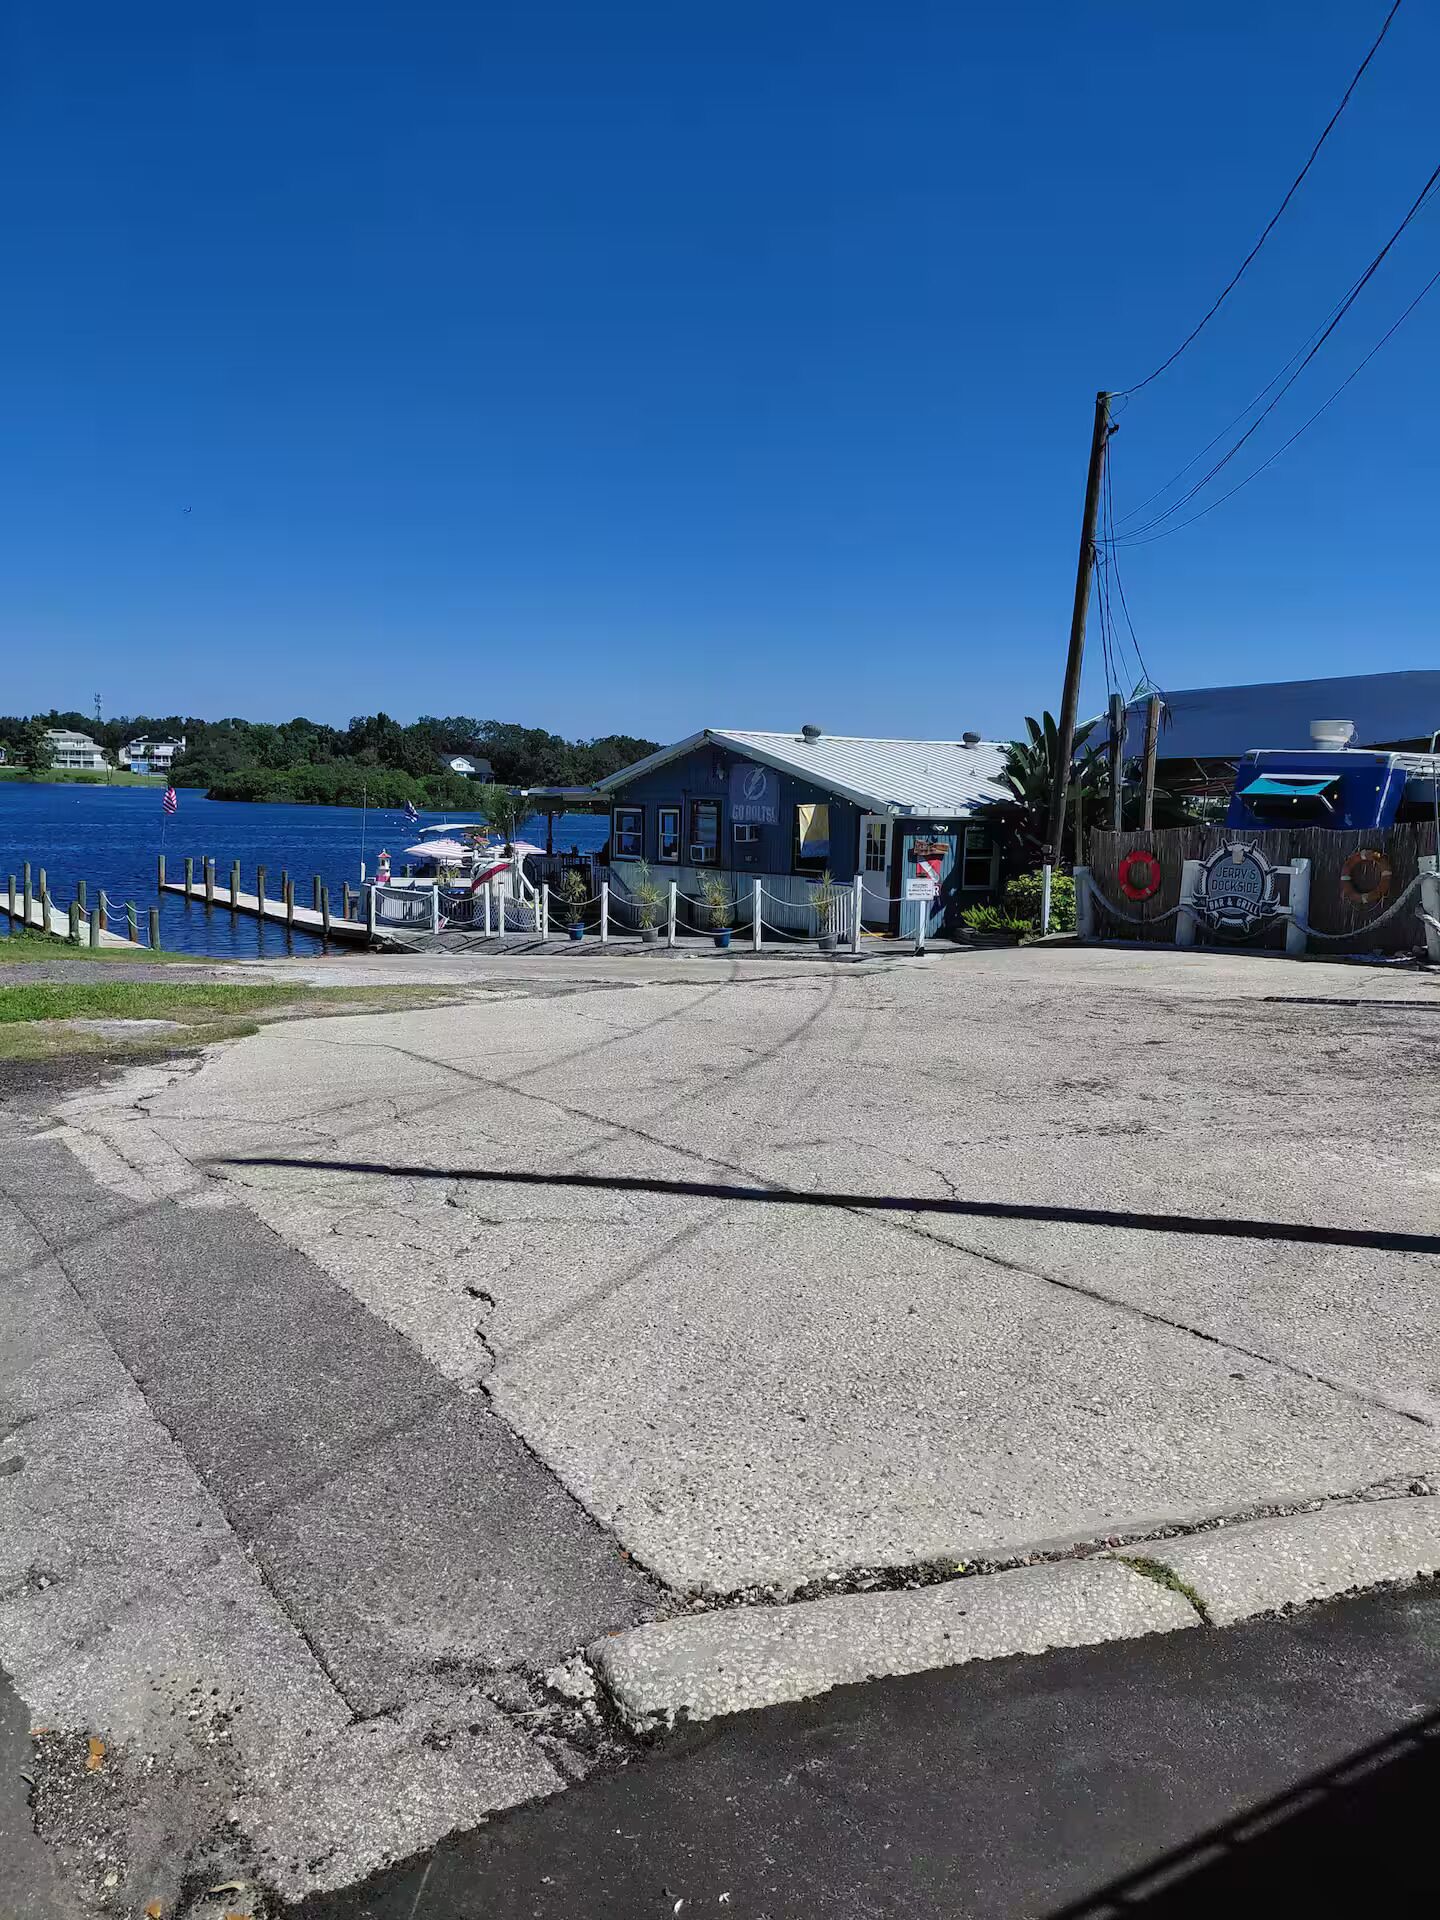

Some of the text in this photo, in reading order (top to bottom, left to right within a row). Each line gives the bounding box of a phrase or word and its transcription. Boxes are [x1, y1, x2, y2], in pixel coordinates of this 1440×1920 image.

[1216, 867, 1256, 880] JERRY'S
[1211, 880, 1258, 893] DOCKSIDE
[1209, 897, 1258, 914] BAR & GRILL
